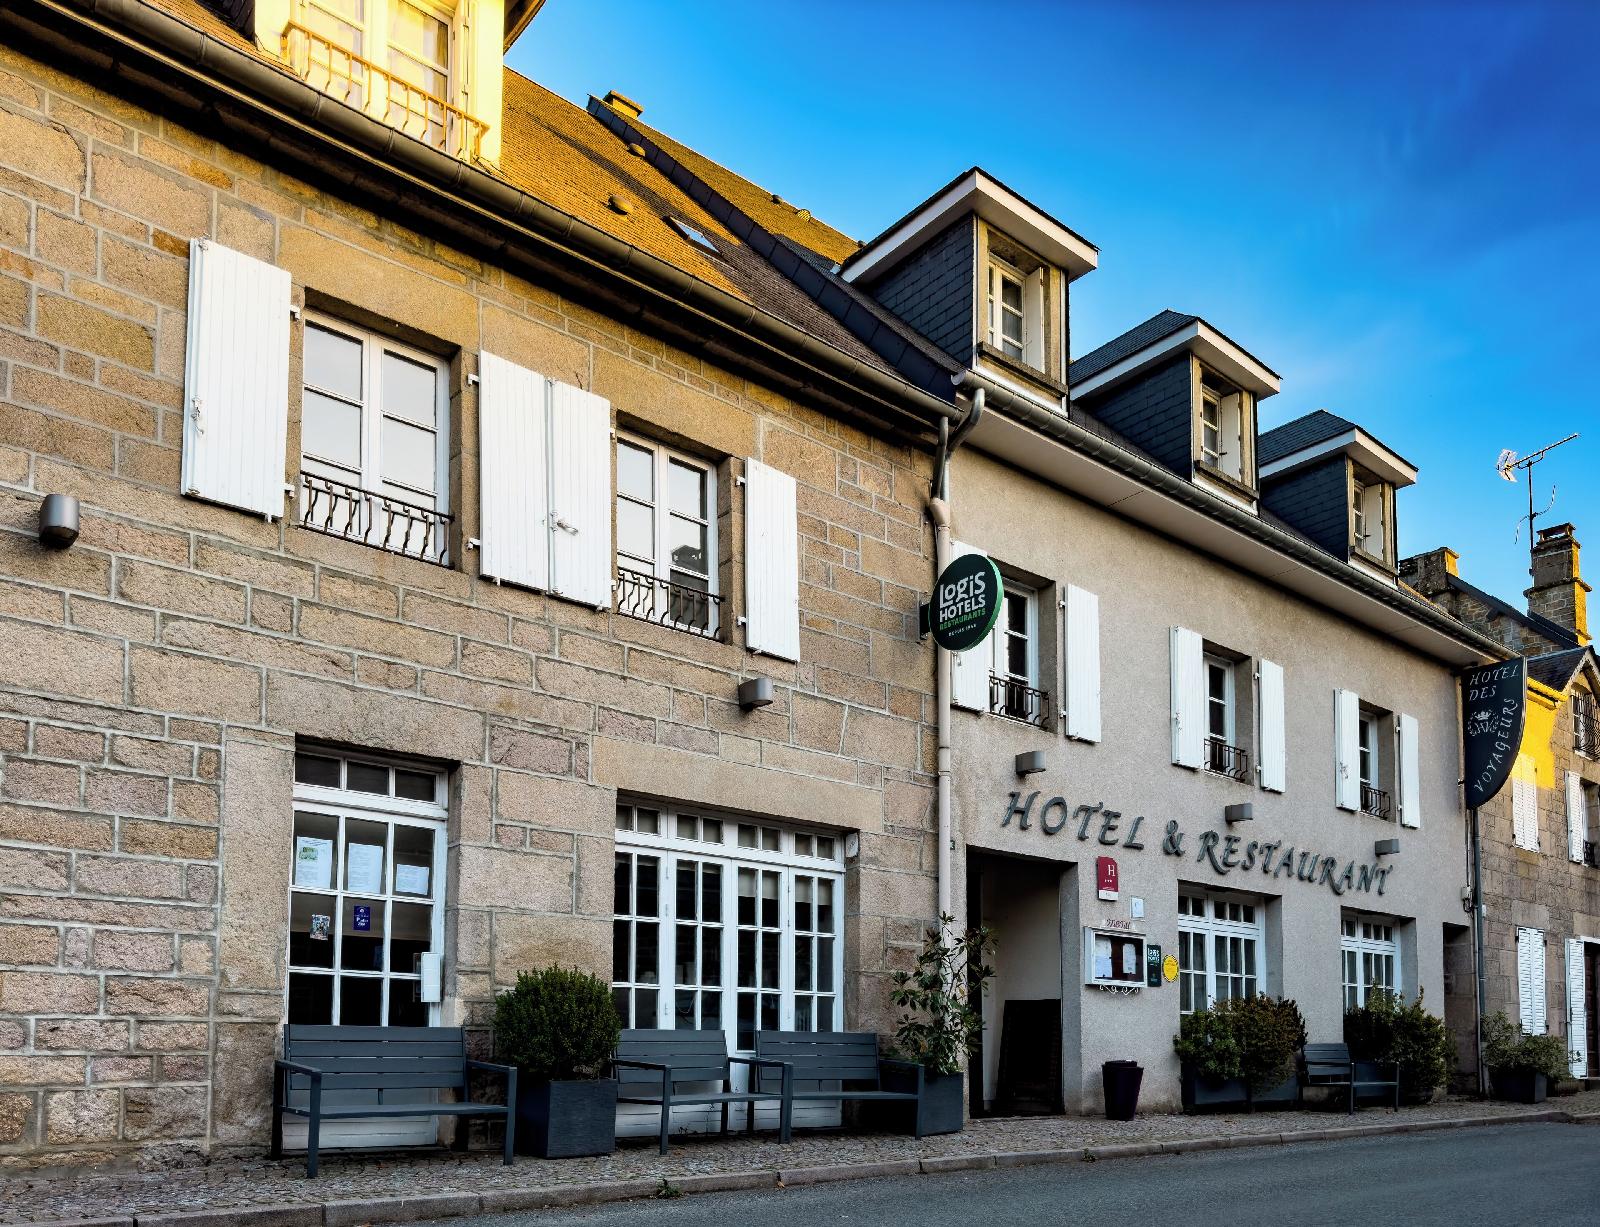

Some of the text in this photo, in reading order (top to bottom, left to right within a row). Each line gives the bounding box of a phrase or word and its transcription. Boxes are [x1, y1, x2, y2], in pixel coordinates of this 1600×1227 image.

[940, 594, 986, 622] HOTELS
[940, 608, 986, 630] RESTAURANTS
[1469, 664, 1519, 686] HOTEL
[1469, 685, 1497, 701] DES
[1474, 698, 1519, 793] VOYAGEURS
[1001, 790, 1393, 896] HOTEL & RESTAURANT
[1107, 864, 1116, 877] H
